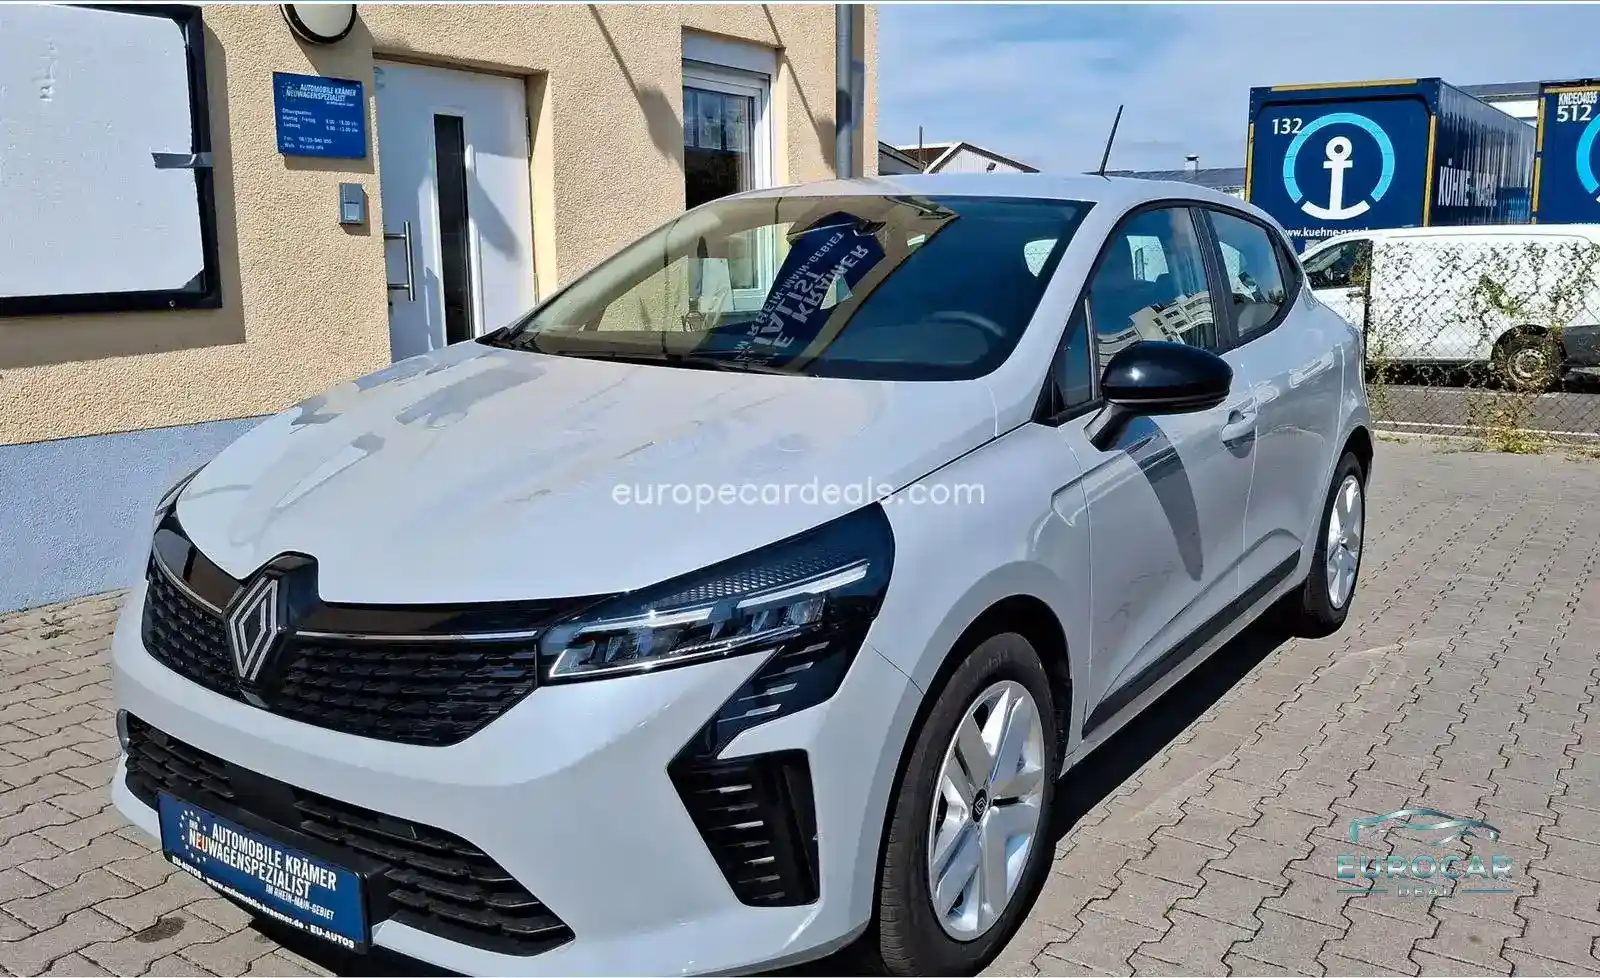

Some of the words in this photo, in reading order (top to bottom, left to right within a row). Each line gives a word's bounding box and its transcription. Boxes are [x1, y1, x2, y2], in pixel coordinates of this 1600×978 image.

[285, 88, 347, 102] NEUWAGENSPEZIALIST
[300, 83, 334, 95] AUTOMOBILE
[334, 86, 357, 97] KRÄMER
[1556, 104, 1592, 122] 512
[1271, 117, 1302, 135] 132
[189, 828, 311, 899] NEUWAGENSPEZIALIST
[212, 823, 282, 869] AUTOMOBILE
[285, 854, 337, 891] KRÄMER
[274, 886, 334, 920] RHEIN-MAIN-GEBIET
[310, 924, 355, 949] EU-AUTOS
